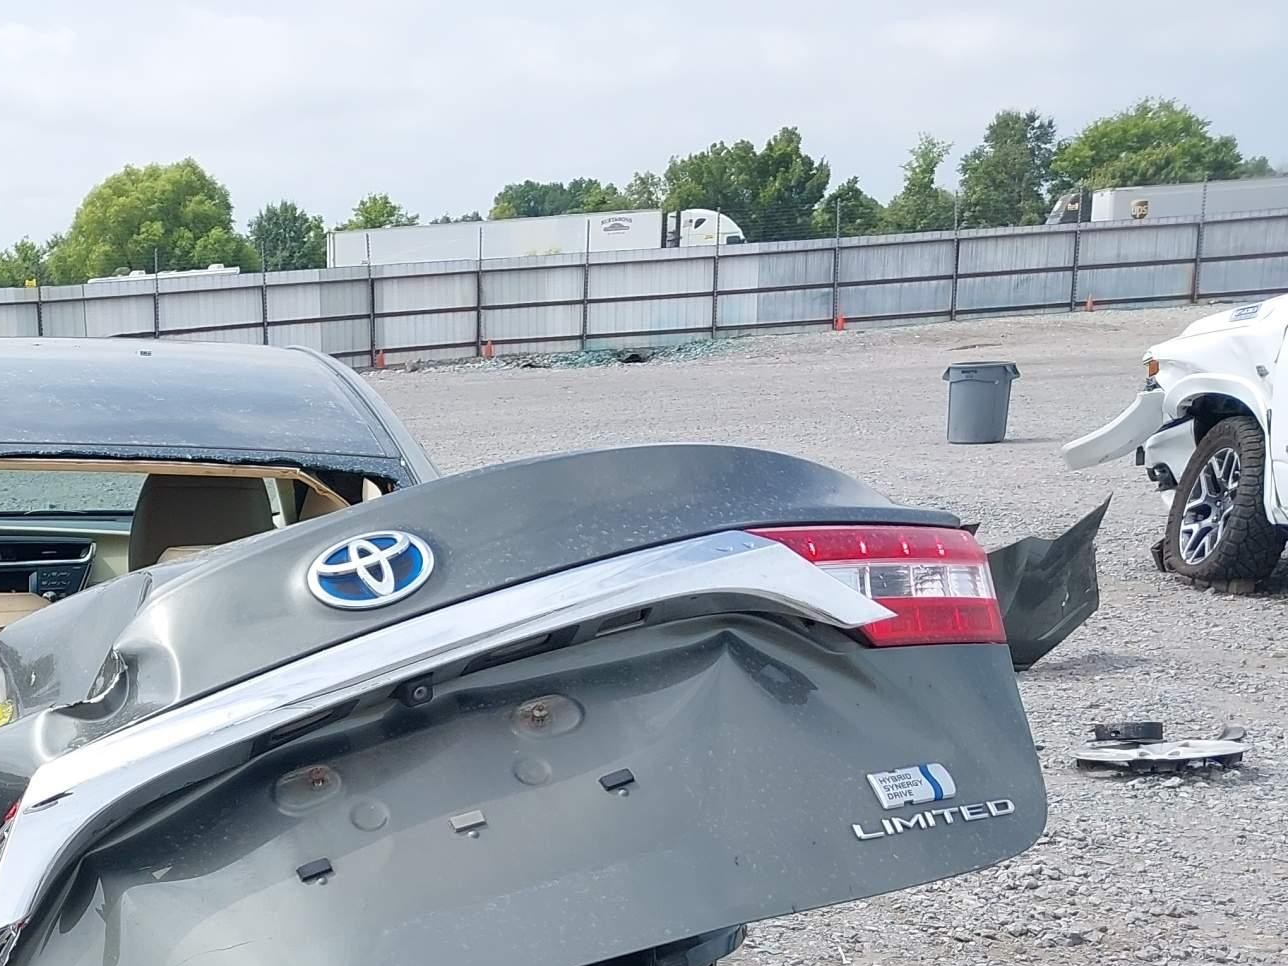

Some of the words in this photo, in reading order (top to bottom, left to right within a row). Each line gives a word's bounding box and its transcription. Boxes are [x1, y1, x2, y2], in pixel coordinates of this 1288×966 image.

[1131, 205, 1148, 218] ups
[878, 773, 912, 785] HYBRID
[883, 778, 923, 792] SYNERGY
[887, 789, 914, 800] DRIVE
[852, 799, 1015, 840] LIMITED
